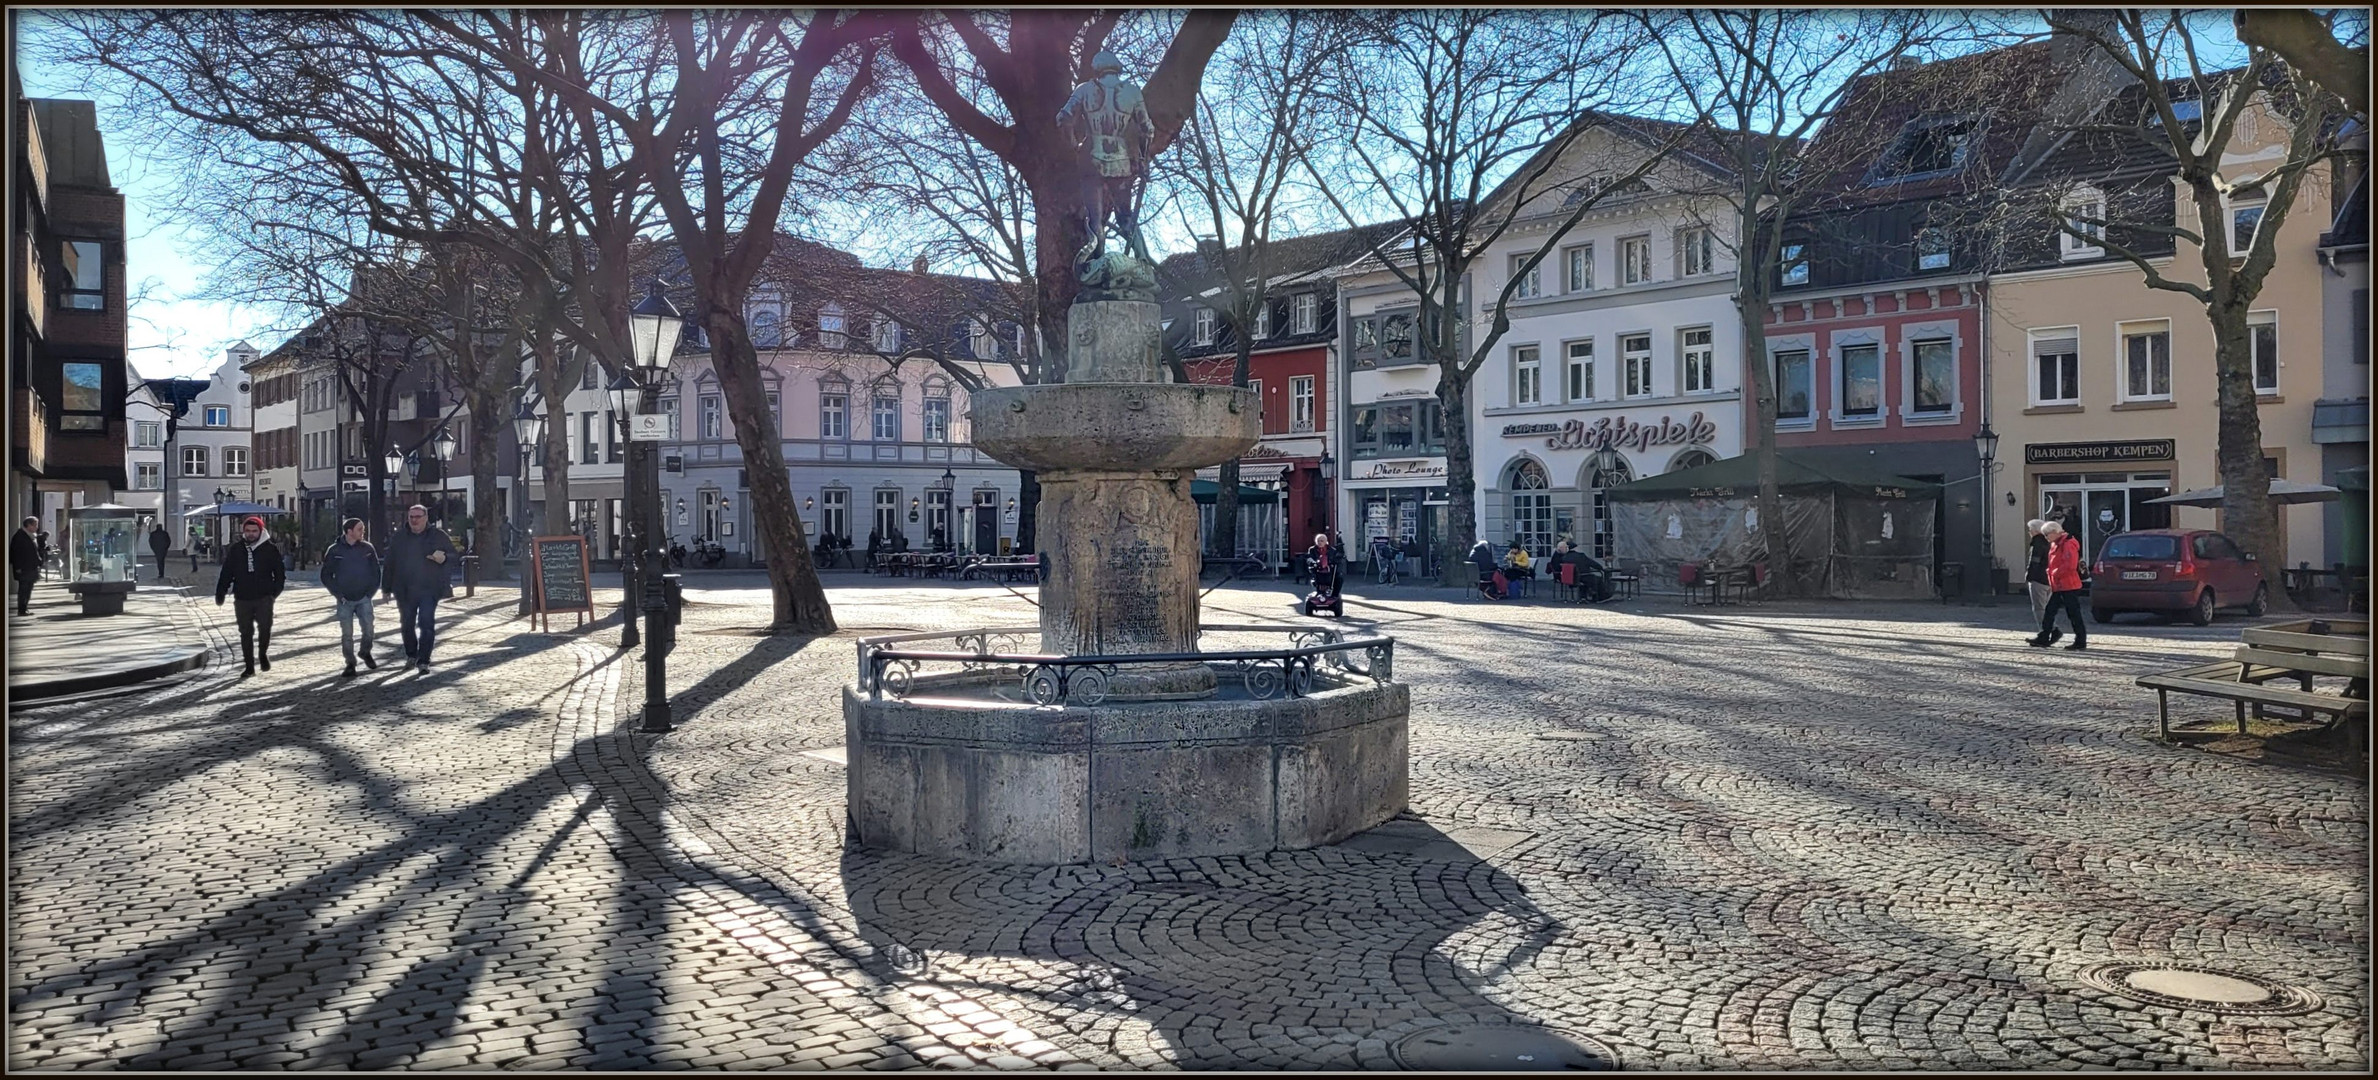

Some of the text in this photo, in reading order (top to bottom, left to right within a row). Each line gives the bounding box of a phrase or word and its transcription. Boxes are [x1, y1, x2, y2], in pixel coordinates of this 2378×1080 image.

[1545, 411, 1716, 453] Lichtspiele
[2034, 444, 2164, 459] BARBERSHOP KEMPEN
[1371, 461, 1443, 478] Photo Lounge
